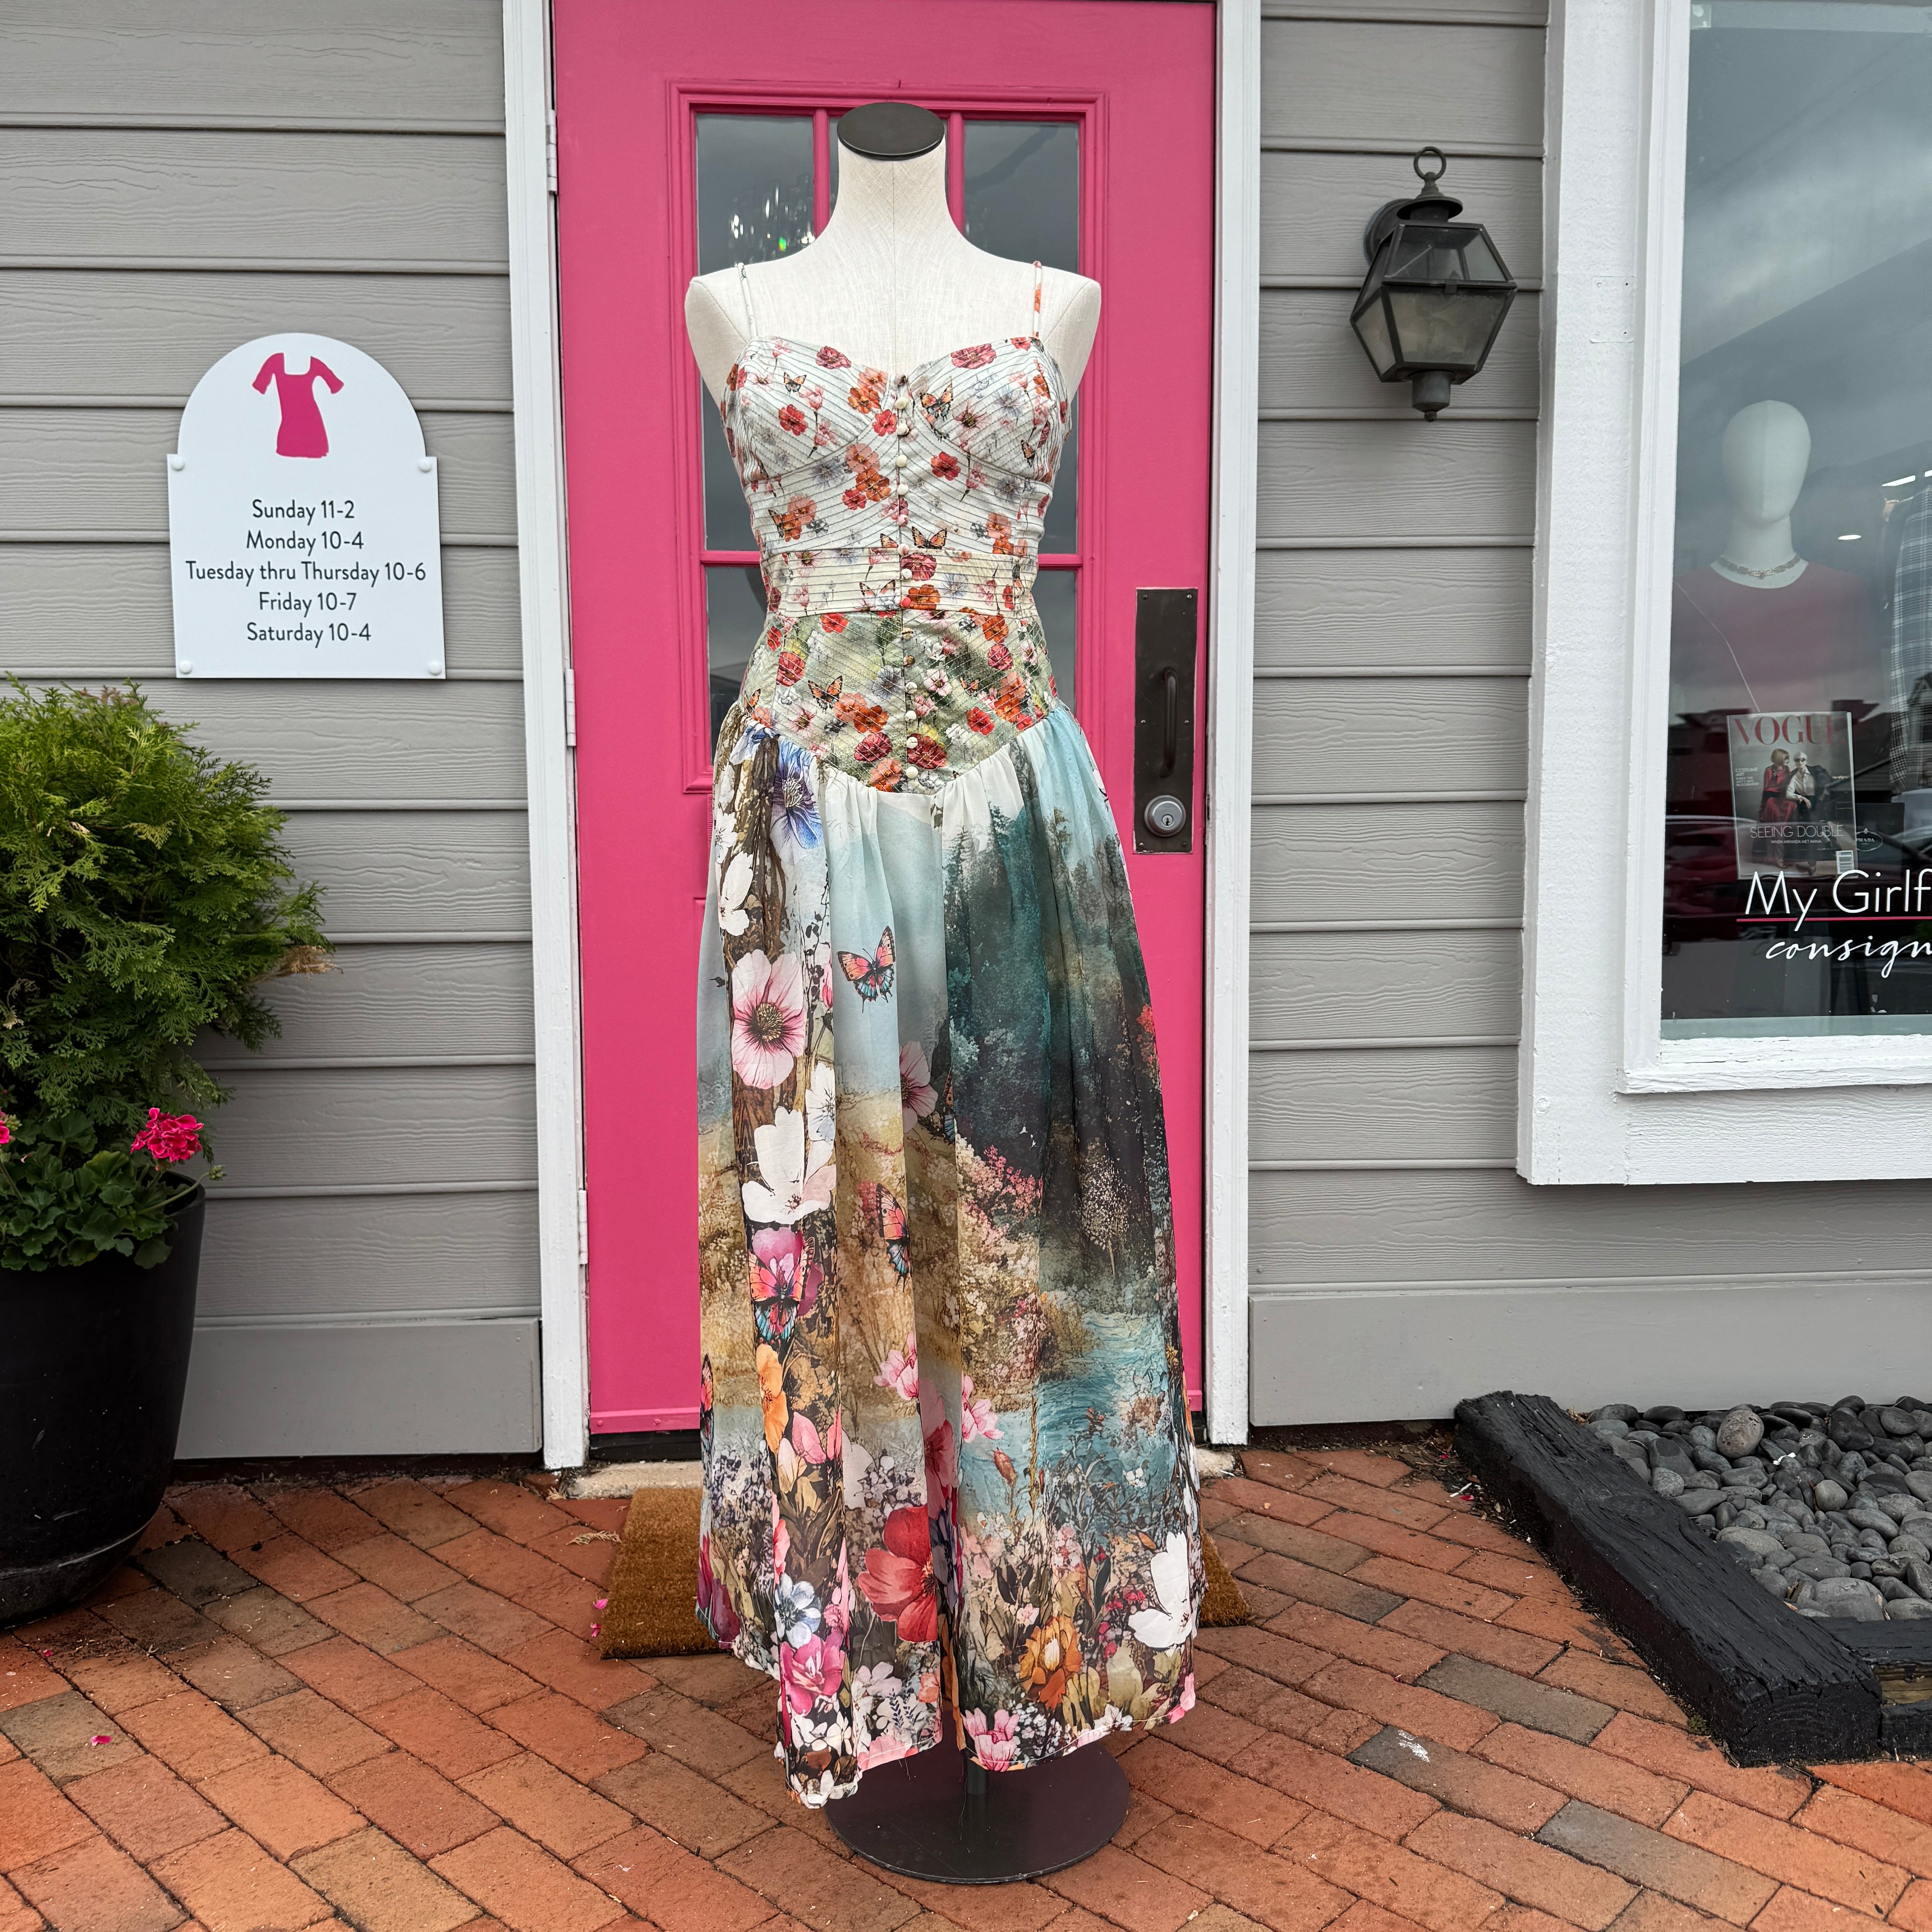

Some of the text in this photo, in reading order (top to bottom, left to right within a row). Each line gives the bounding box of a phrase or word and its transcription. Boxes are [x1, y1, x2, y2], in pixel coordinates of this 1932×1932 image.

[252, 499, 355, 526] Sunday 11-2
[246, 530, 364, 557] Monday 10-4
[185, 561, 426, 588] Tuesday thru Thursday 10-6
[259, 591, 357, 618] Friday 10-7
[247, 622, 372, 649] Saturday 10-4
[1734, 714, 1845, 745] VOGUE
[1750, 825, 1844, 838] SEEING DOUBLE
[1745, 868, 1932, 932] My Girlf
[1766, 935, 1932, 978] consign
